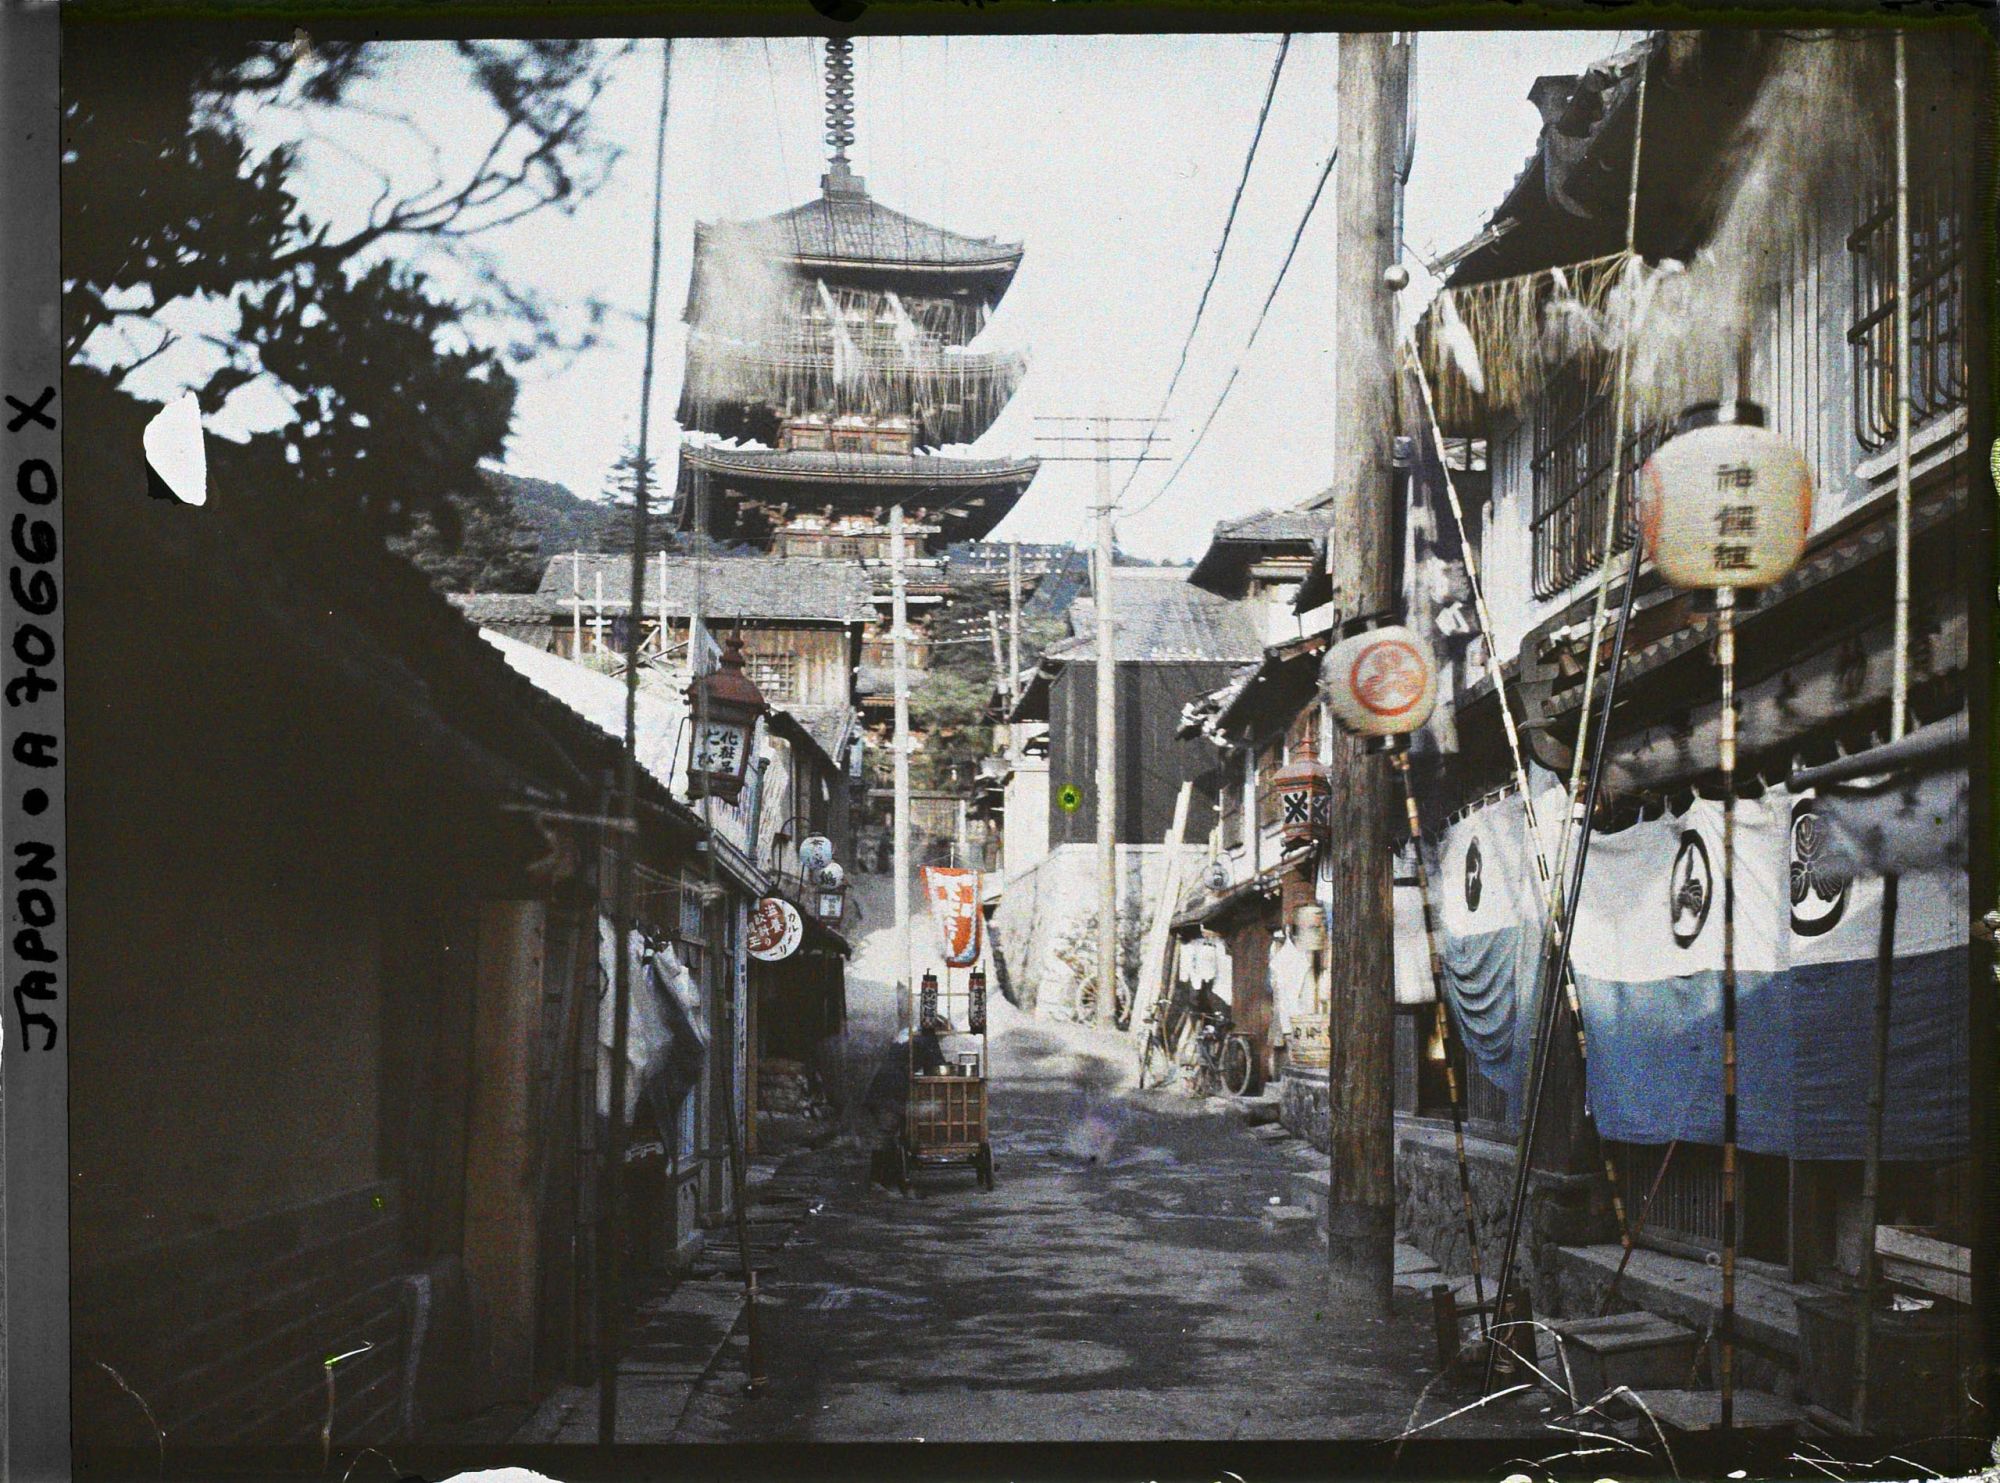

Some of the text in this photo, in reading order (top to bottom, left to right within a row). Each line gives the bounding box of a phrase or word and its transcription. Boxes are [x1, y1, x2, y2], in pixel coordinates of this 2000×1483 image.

[5, 386, 57, 432] X
[5, 458, 58, 707] 70660
[718, 730, 739, 773] 化粧品
[13, 841, 58, 1052] JAPON
